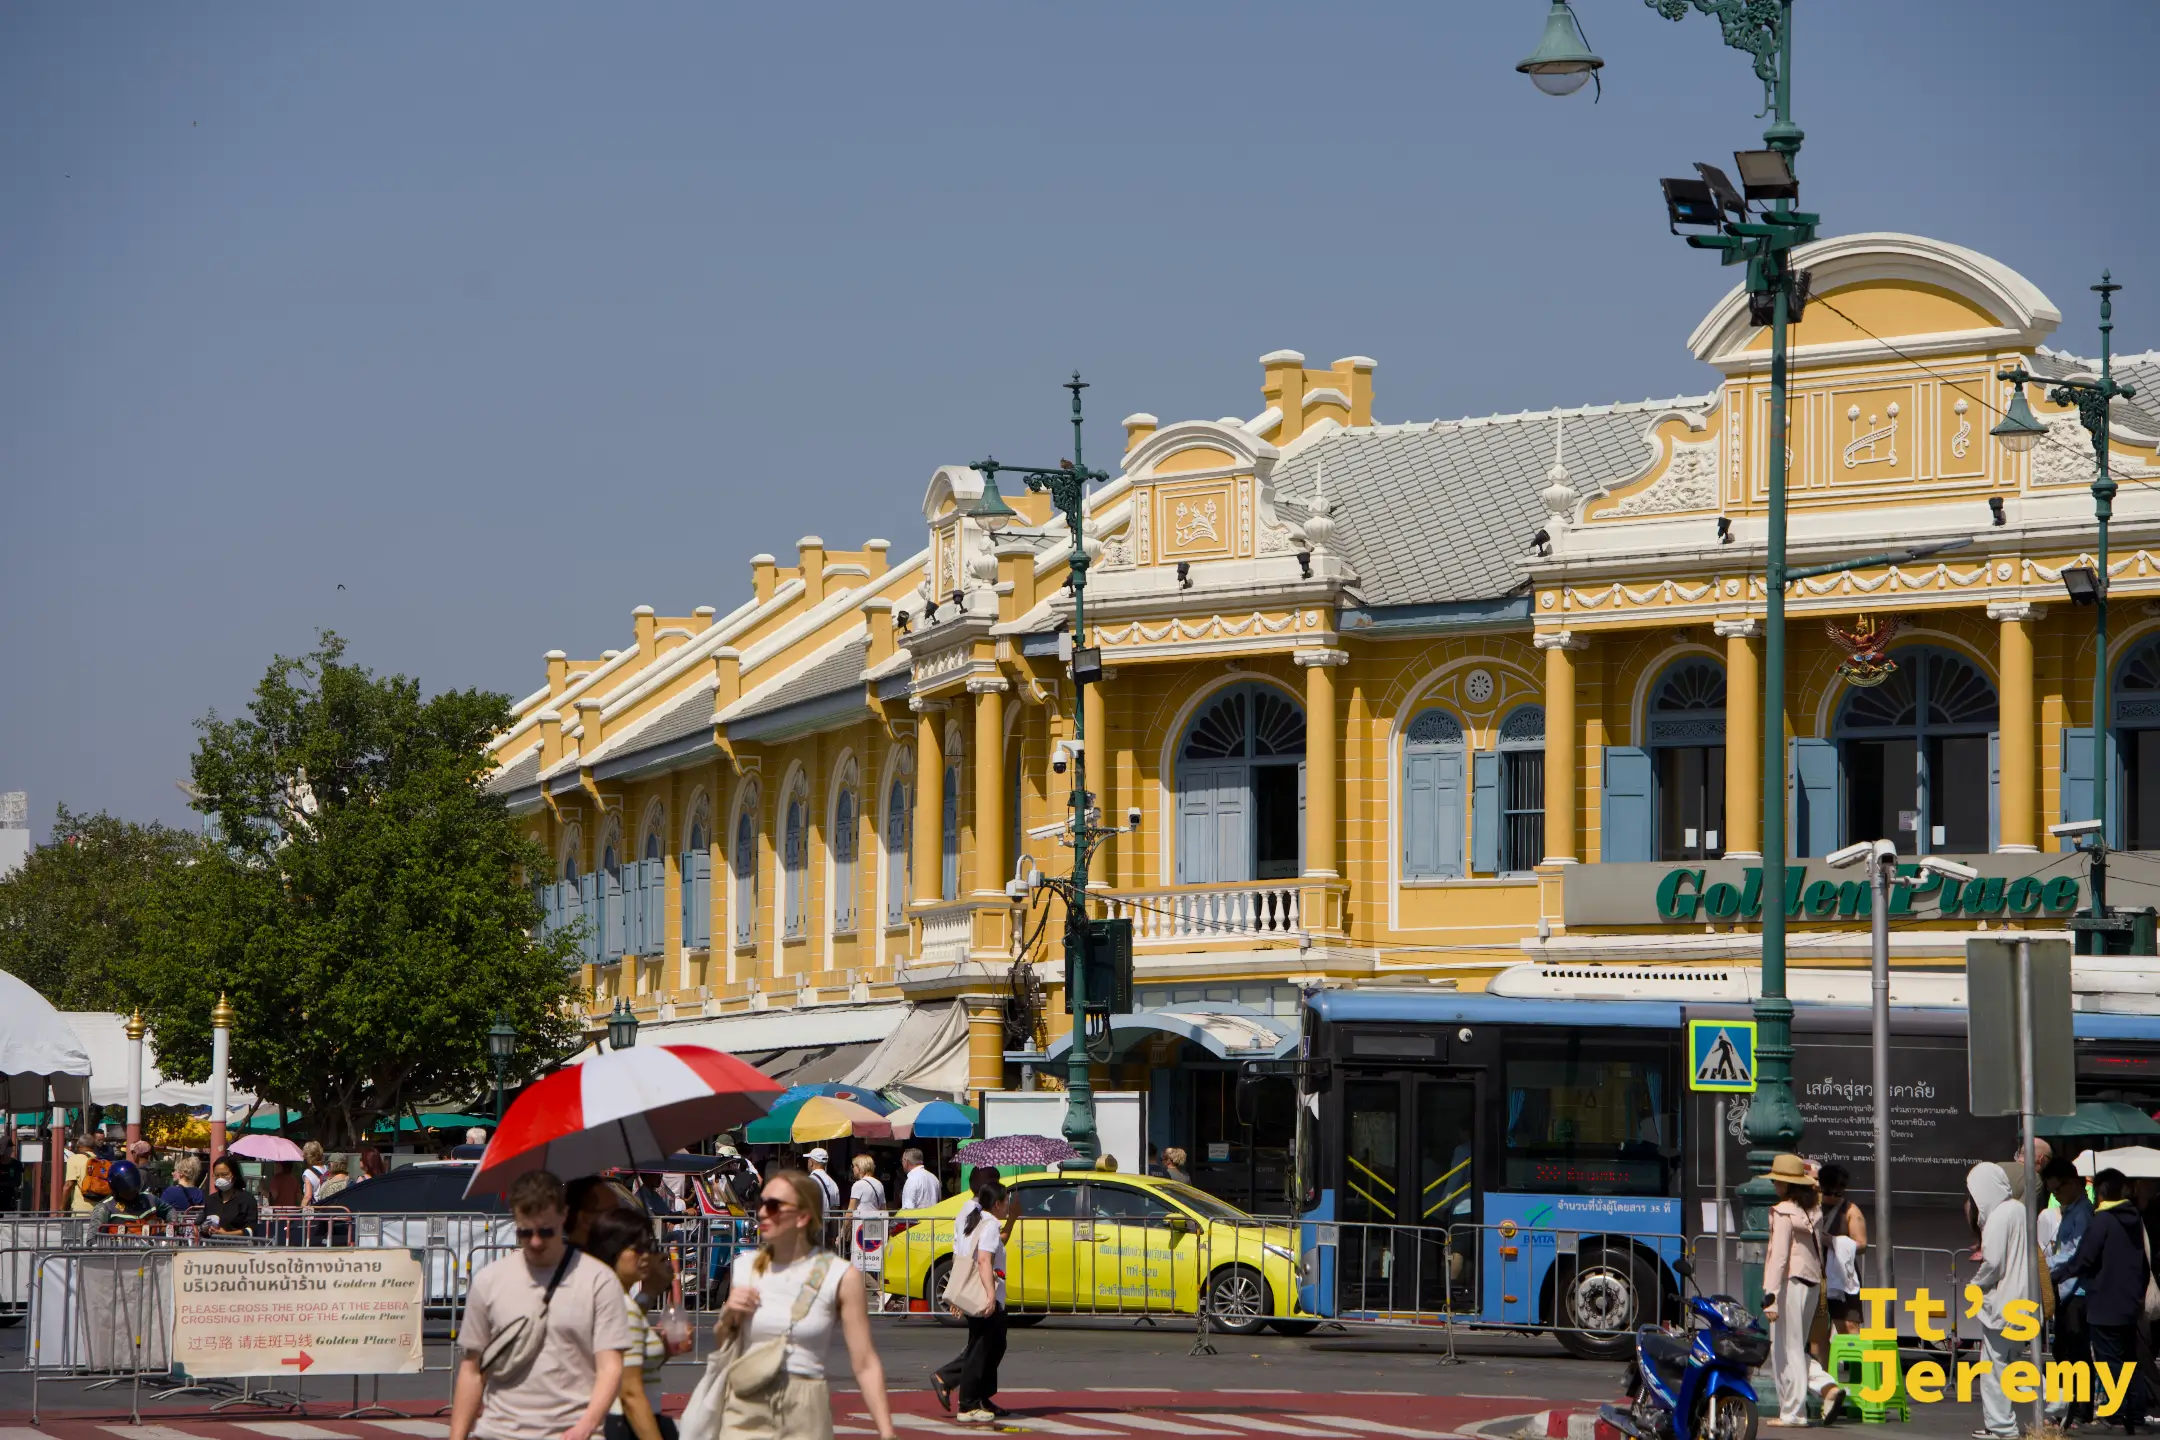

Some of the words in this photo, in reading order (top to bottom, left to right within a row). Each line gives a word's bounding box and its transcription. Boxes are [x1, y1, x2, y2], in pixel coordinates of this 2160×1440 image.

[1888, 862, 2080, 914] Place
[1806, 1077, 1935, 1101] เสด็จสู่สวคาลัย
[1557, 1198, 1646, 1215] จำนวนที่นั่งผู้โดยสาร
[1523, 1235, 1555, 1244] BMTA
[183, 1258, 382, 1275] ข้ามถนนโปรดใช้ทางม้าลาย
[183, 1276, 326, 1292] บริเวณด้านหน้าร้าน
[333, 1279, 376, 1288] Golden
[381, 1278, 415, 1288] Place
[181, 1304, 226, 1314] PLEASE
[229, 1303, 269, 1313] CROSS
[272, 1303, 293, 1312] THE
[296, 1302, 328, 1311] ROAD
[331, 1302, 346, 1311] AT
[349, 1301, 371, 1310] THE
[373, 1301, 409, 1310] ZEBRA
[181, 1314, 240, 1324] CROSSING
[243, 1314, 255, 1323] IN
[257, 1313, 295, 1323] FRONT
[298, 1312, 314, 1322] OF
[316, 1312, 338, 1321] THE
[341, 1312, 376, 1321] Golden
[379, 1312, 406, 1321] Place
[188, 1335, 233, 1350] 过马路
[238, 1333, 313, 1349] 请走斑马线
[315, 1335, 359, 1345] Golden
[363, 1335, 397, 1345] Place
[398, 1332, 413, 1347] 店
